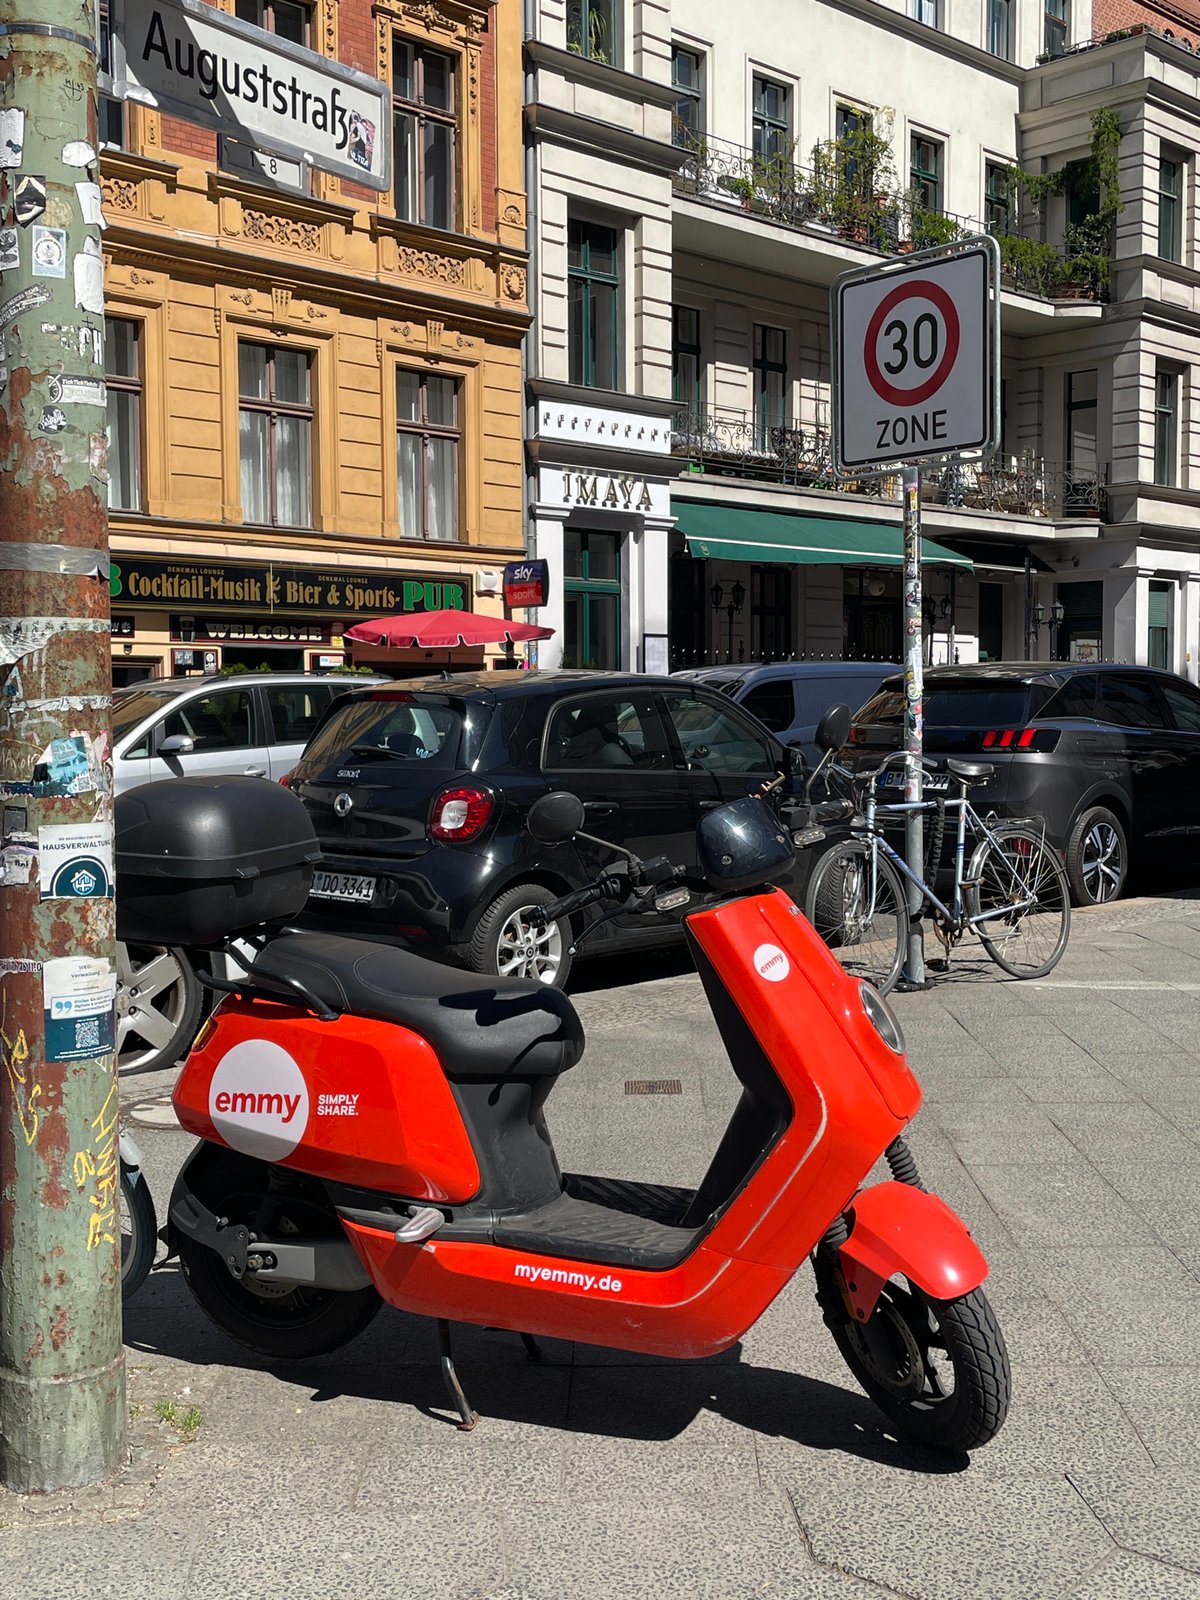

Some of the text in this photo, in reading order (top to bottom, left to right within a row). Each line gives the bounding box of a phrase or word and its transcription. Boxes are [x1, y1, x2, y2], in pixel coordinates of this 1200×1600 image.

[143, 11, 350, 150] Auguststraß
[883, 312, 938, 375] 30
[543, 411, 672, 439] RESTAURANT
[876, 409, 947, 448] ZONE
[563, 473, 654, 507] IMAYA
[167, 566, 225, 576] DENKMAL LOUNGE
[317, 575, 346, 583] DENKMAL
[514, 565, 534, 581] sky
[128, 571, 261, 602] Cocktail-Musik
[286, 580, 323, 605] Bier
[326, 584, 341, 606] &
[402, 580, 464, 611] PUB
[206, 622, 323, 641] WELCOME
[336, 769, 361, 778] smart
[42, 839, 110, 851] HAUSVERWALTUNG
[321, 874, 339, 893] DO
[340, 876, 373, 898] 3341
[759, 950, 784, 974] emmy
[215, 1091, 302, 1123] emmy
[317, 1094, 359, 1105] SIMPLY
[317, 1105, 359, 1116] SHARE.
[514, 1264, 622, 1292] myemmy.de
